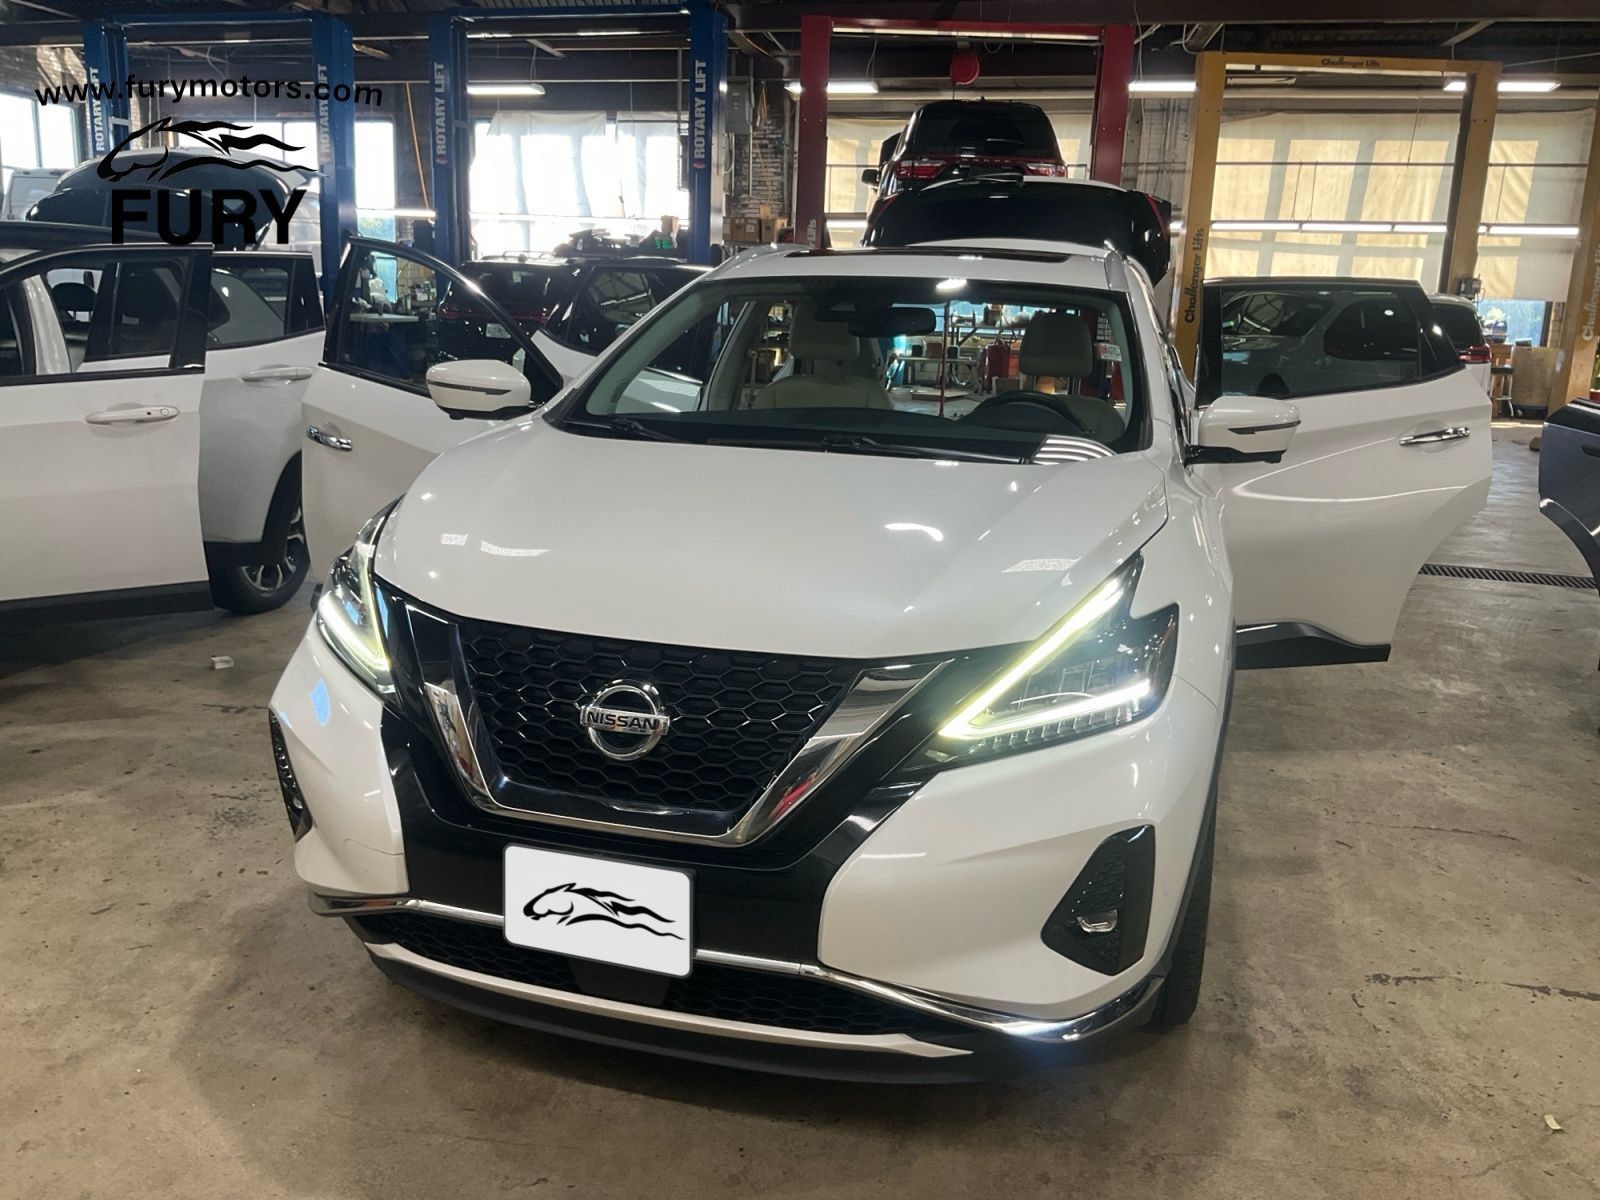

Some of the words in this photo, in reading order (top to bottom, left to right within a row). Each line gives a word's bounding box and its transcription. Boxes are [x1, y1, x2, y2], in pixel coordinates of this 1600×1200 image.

[433, 62, 445, 93] LIFT
[695, 59, 707, 93] LIFT
[92, 97, 105, 152] ROTARY
[319, 99, 331, 153] ROTARY
[434, 97, 447, 155] ROTARY
[694, 97, 706, 159] ROTARY
[1192, 227, 1205, 251] Lifts
[1184, 253, 1203, 324] Challenger
[586, 711, 657, 731] NISSAN
